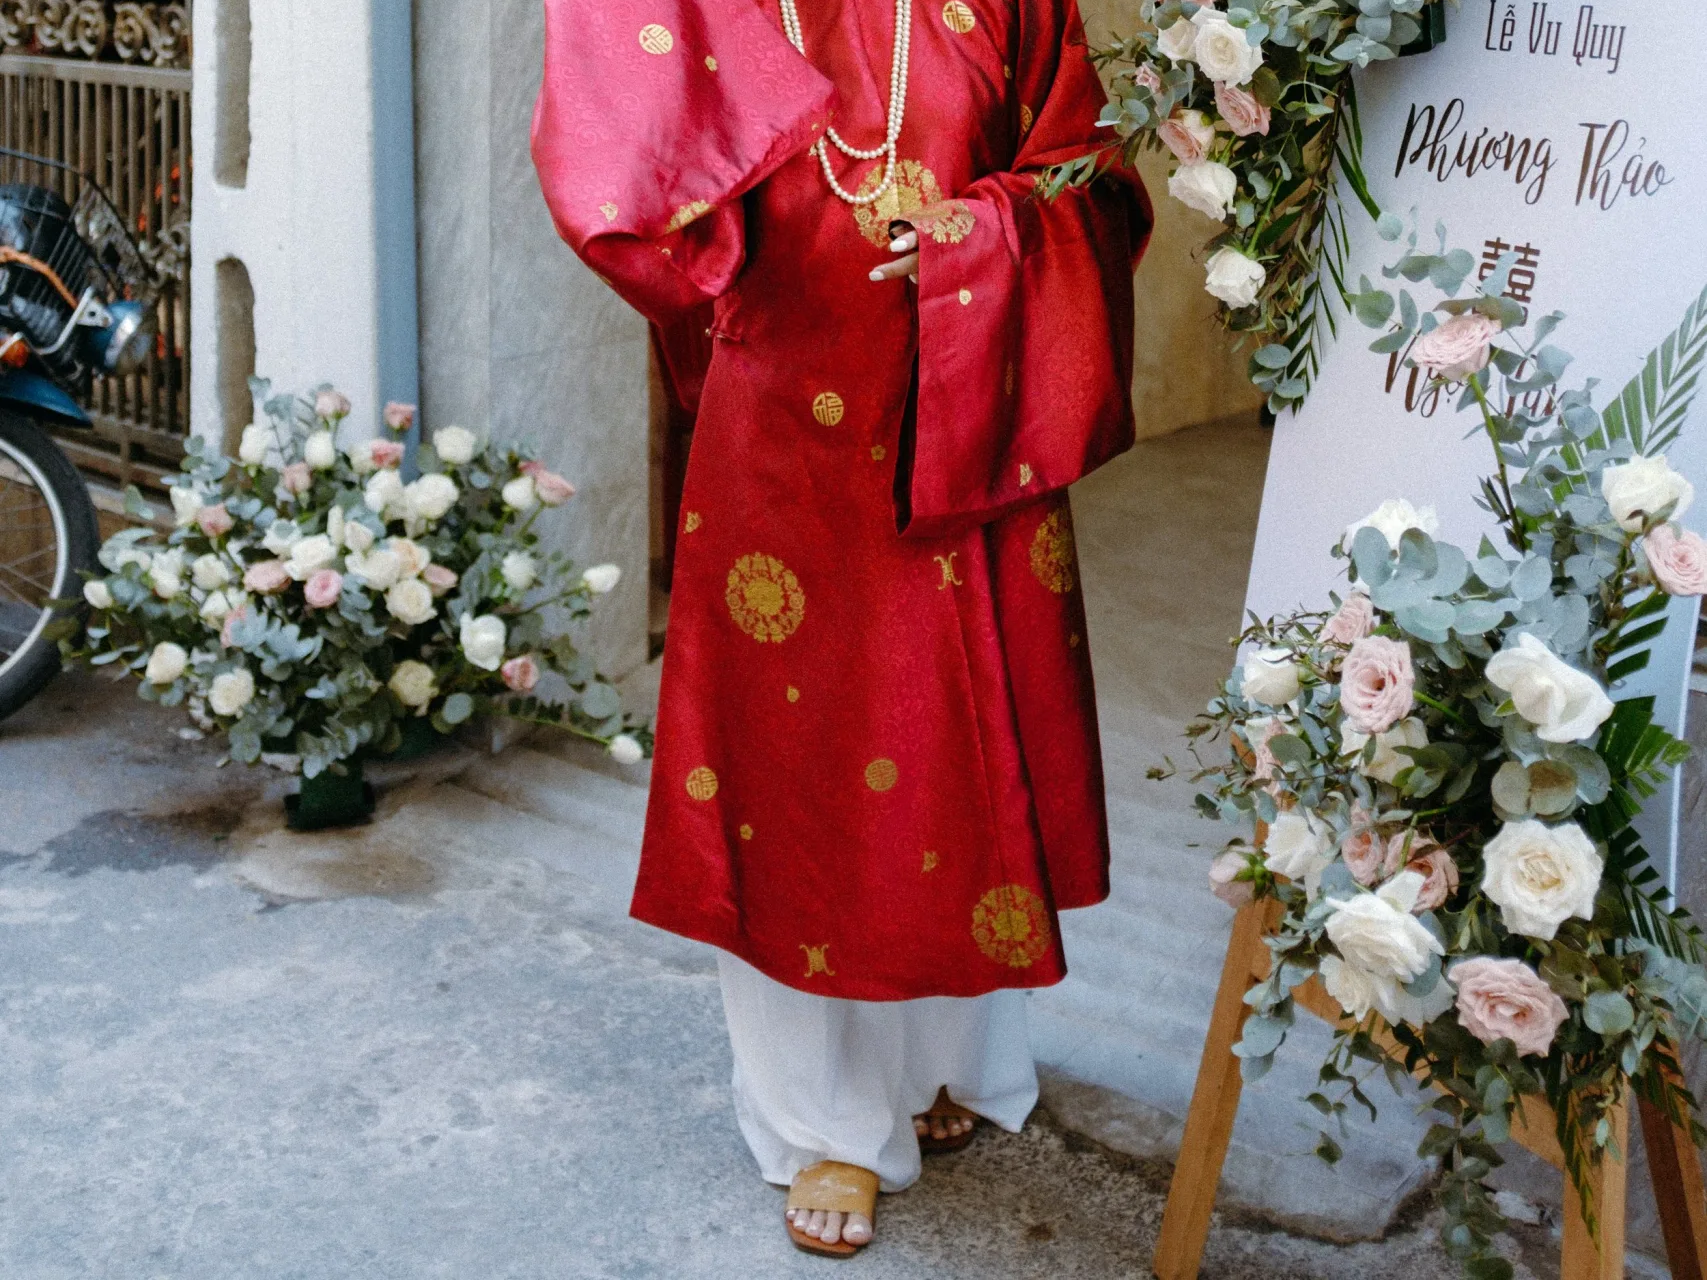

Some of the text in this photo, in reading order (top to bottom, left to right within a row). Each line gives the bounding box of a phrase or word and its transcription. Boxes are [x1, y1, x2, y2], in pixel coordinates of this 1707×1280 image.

[1485, 0, 1626, 74] Lễ Vu Quy
[1395, 98, 1675, 211] Phương Thảo
